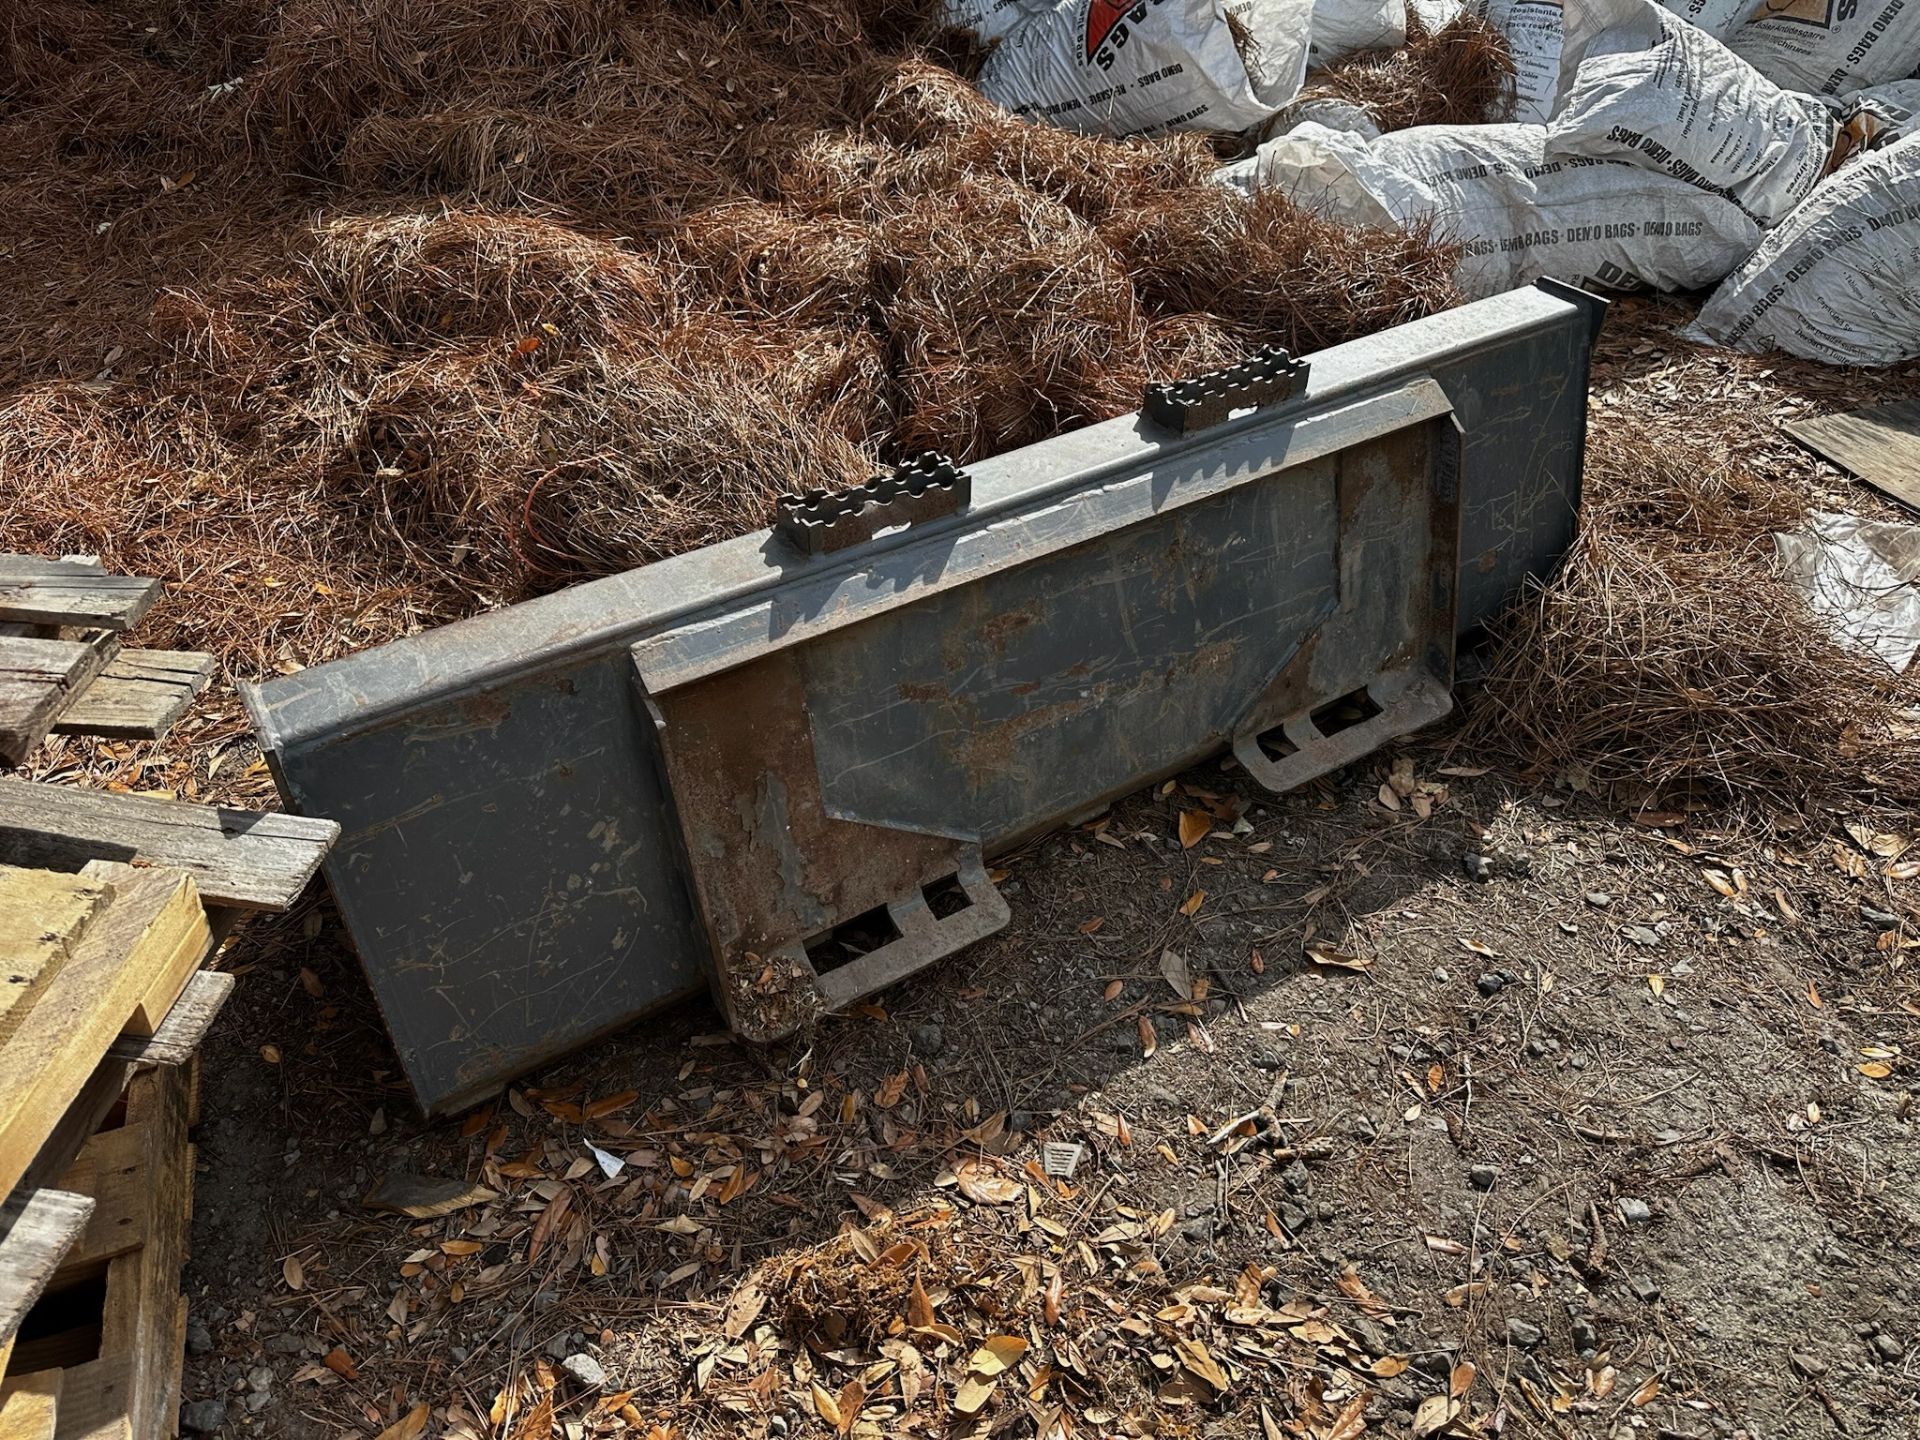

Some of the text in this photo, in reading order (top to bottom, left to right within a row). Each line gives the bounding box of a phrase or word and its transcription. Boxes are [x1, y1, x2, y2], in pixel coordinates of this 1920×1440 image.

[1872, 0, 1905, 32] DEMO
[1097, 0, 1164, 71] AGS
[1846, 30, 1879, 65] BAGS
[1138, 70, 1161, 88] BAGS
[1162, 63, 1184, 78] DEMO
[1188, 104, 1209, 120] BAGS
[1639, 137, 1672, 164] DEMO
[1455, 164, 1487, 181] DEMO
[1524, 160, 1562, 180] DEMO
[1466, 240, 1494, 257] BAGS
[1525, 230, 1559, 247] BAGS
[1605, 222, 1635, 239] BAGS
[1643, 221, 1673, 237] DEMO
[1675, 221, 1703, 237] BAGS
[1725, 314, 1755, 346] DEMO
[1752, 285, 1785, 317] BAGS
[1785, 248, 1825, 283] DEMO
